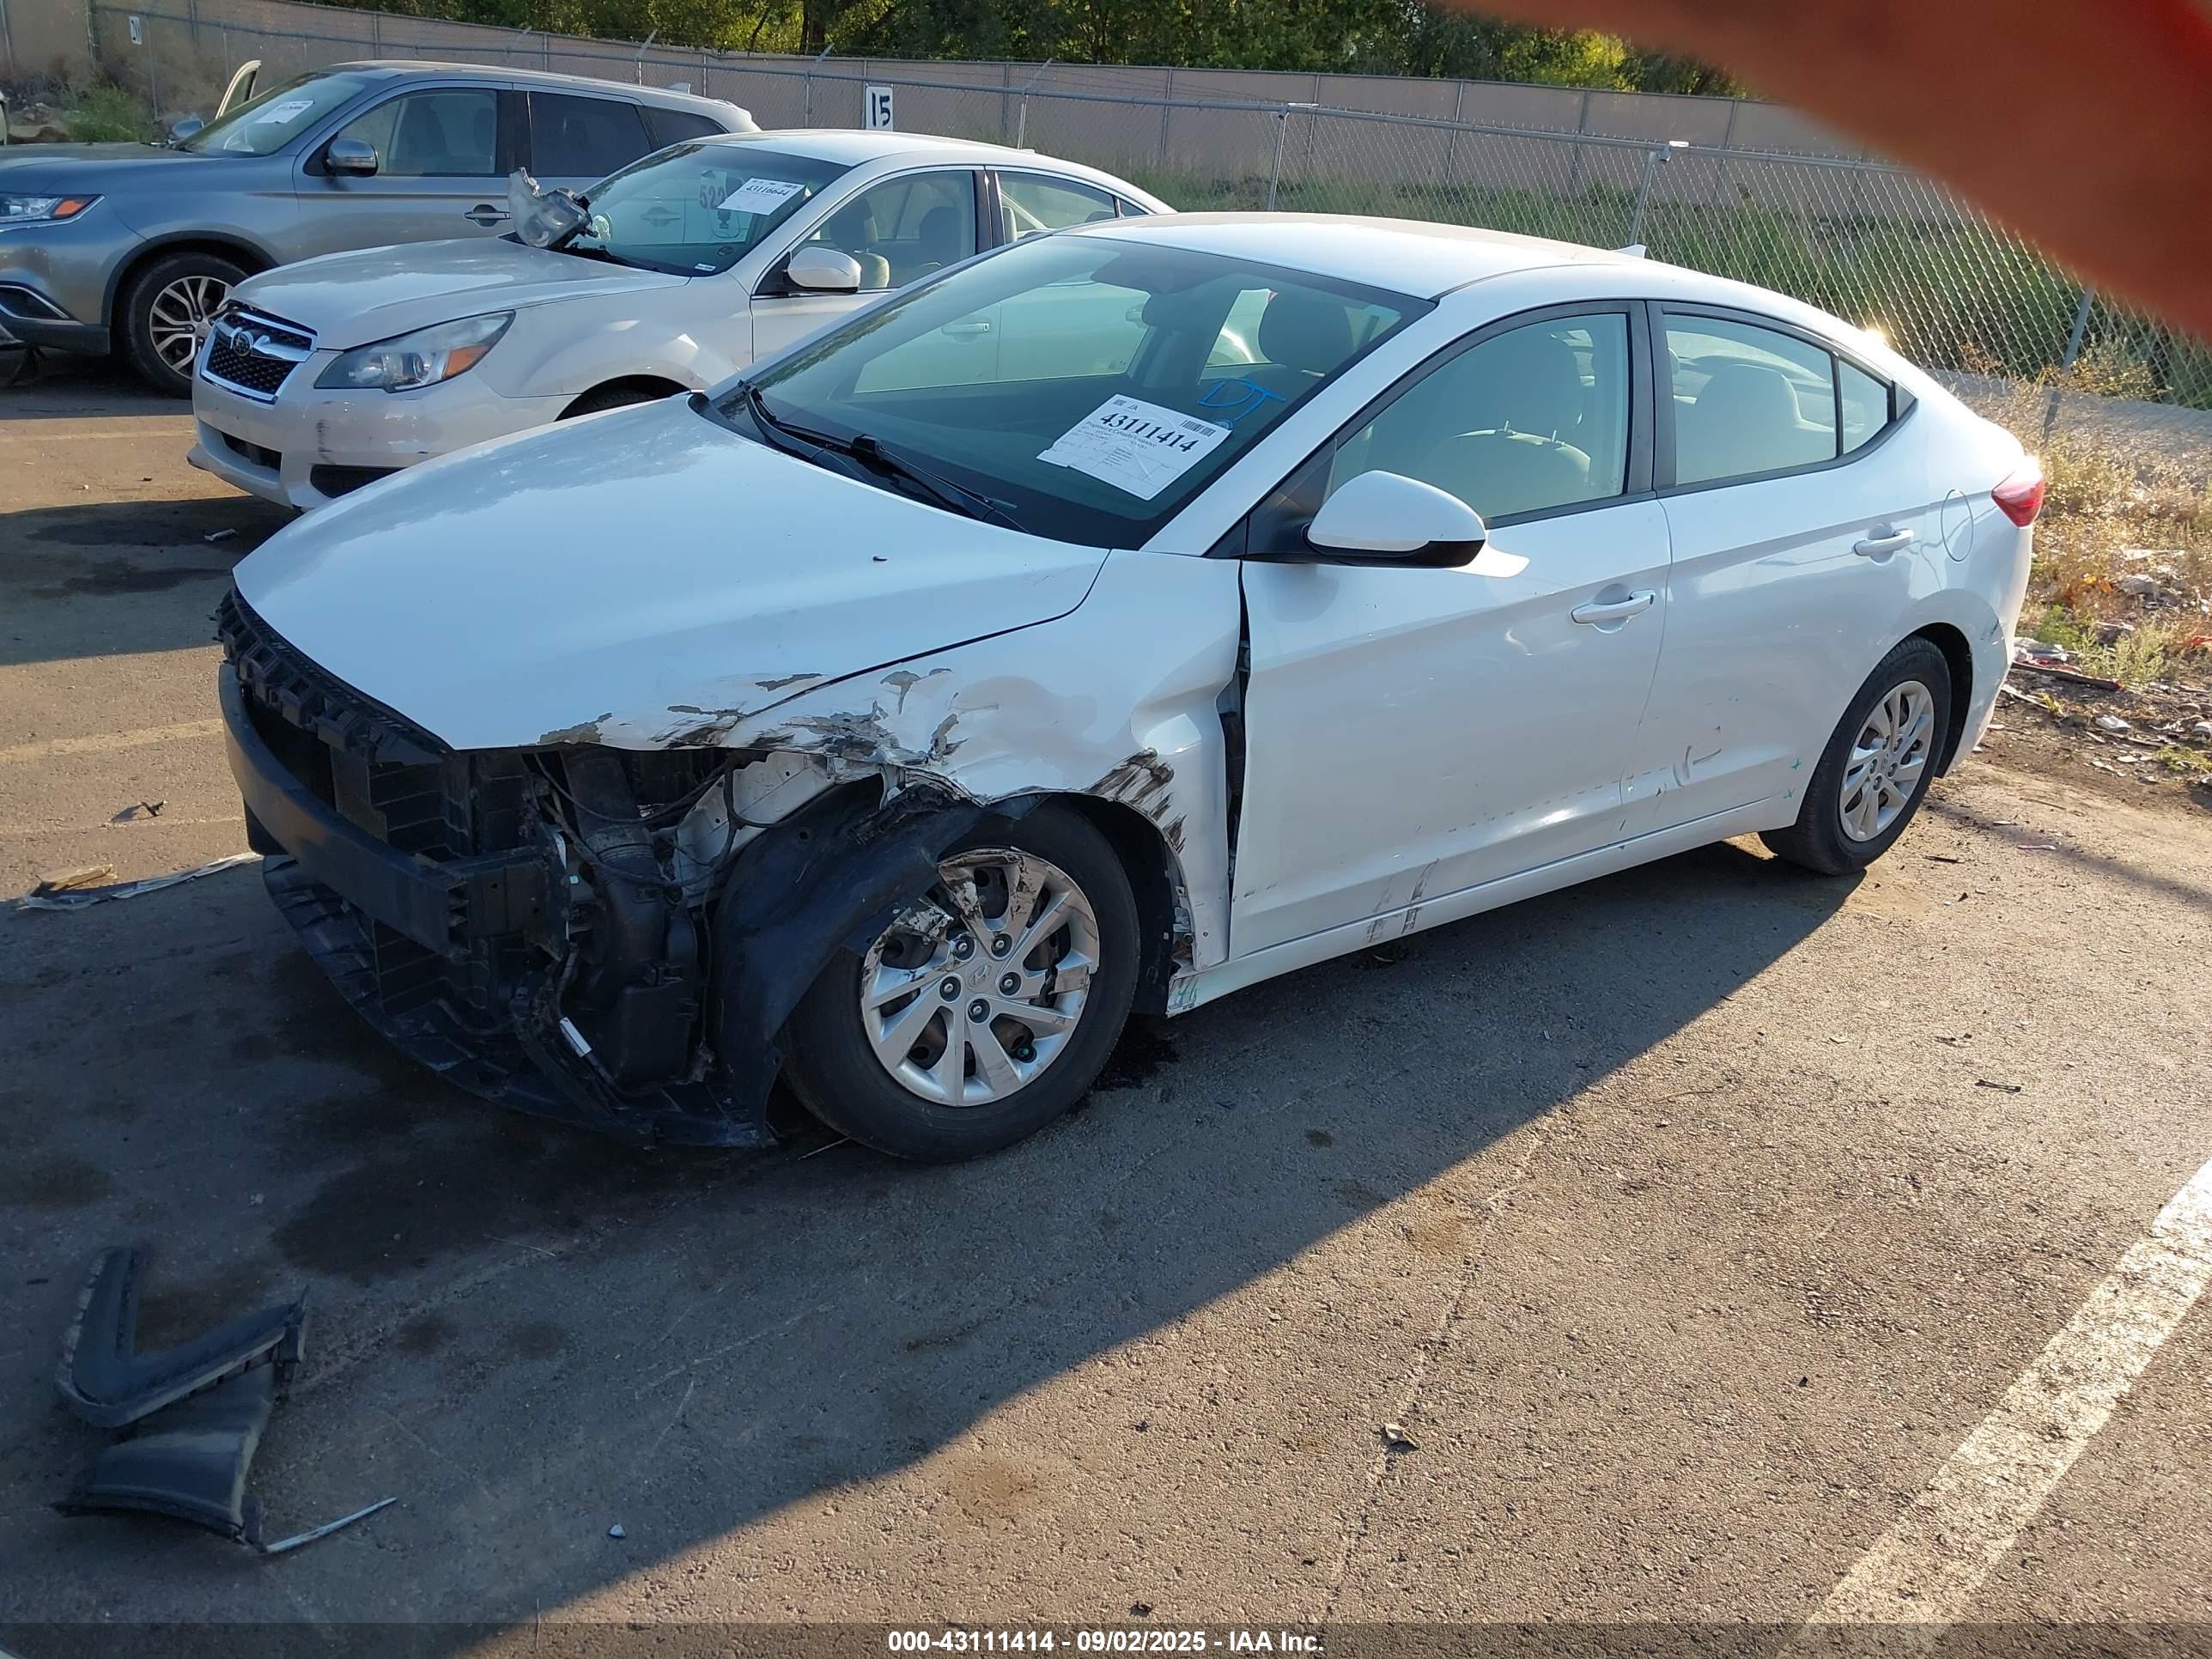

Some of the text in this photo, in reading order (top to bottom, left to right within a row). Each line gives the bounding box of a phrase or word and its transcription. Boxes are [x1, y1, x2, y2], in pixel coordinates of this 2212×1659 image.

[872, 92, 891, 127] 15
[1196, 378, 1285, 421] DT
[1099, 412, 1200, 453] 43111414
